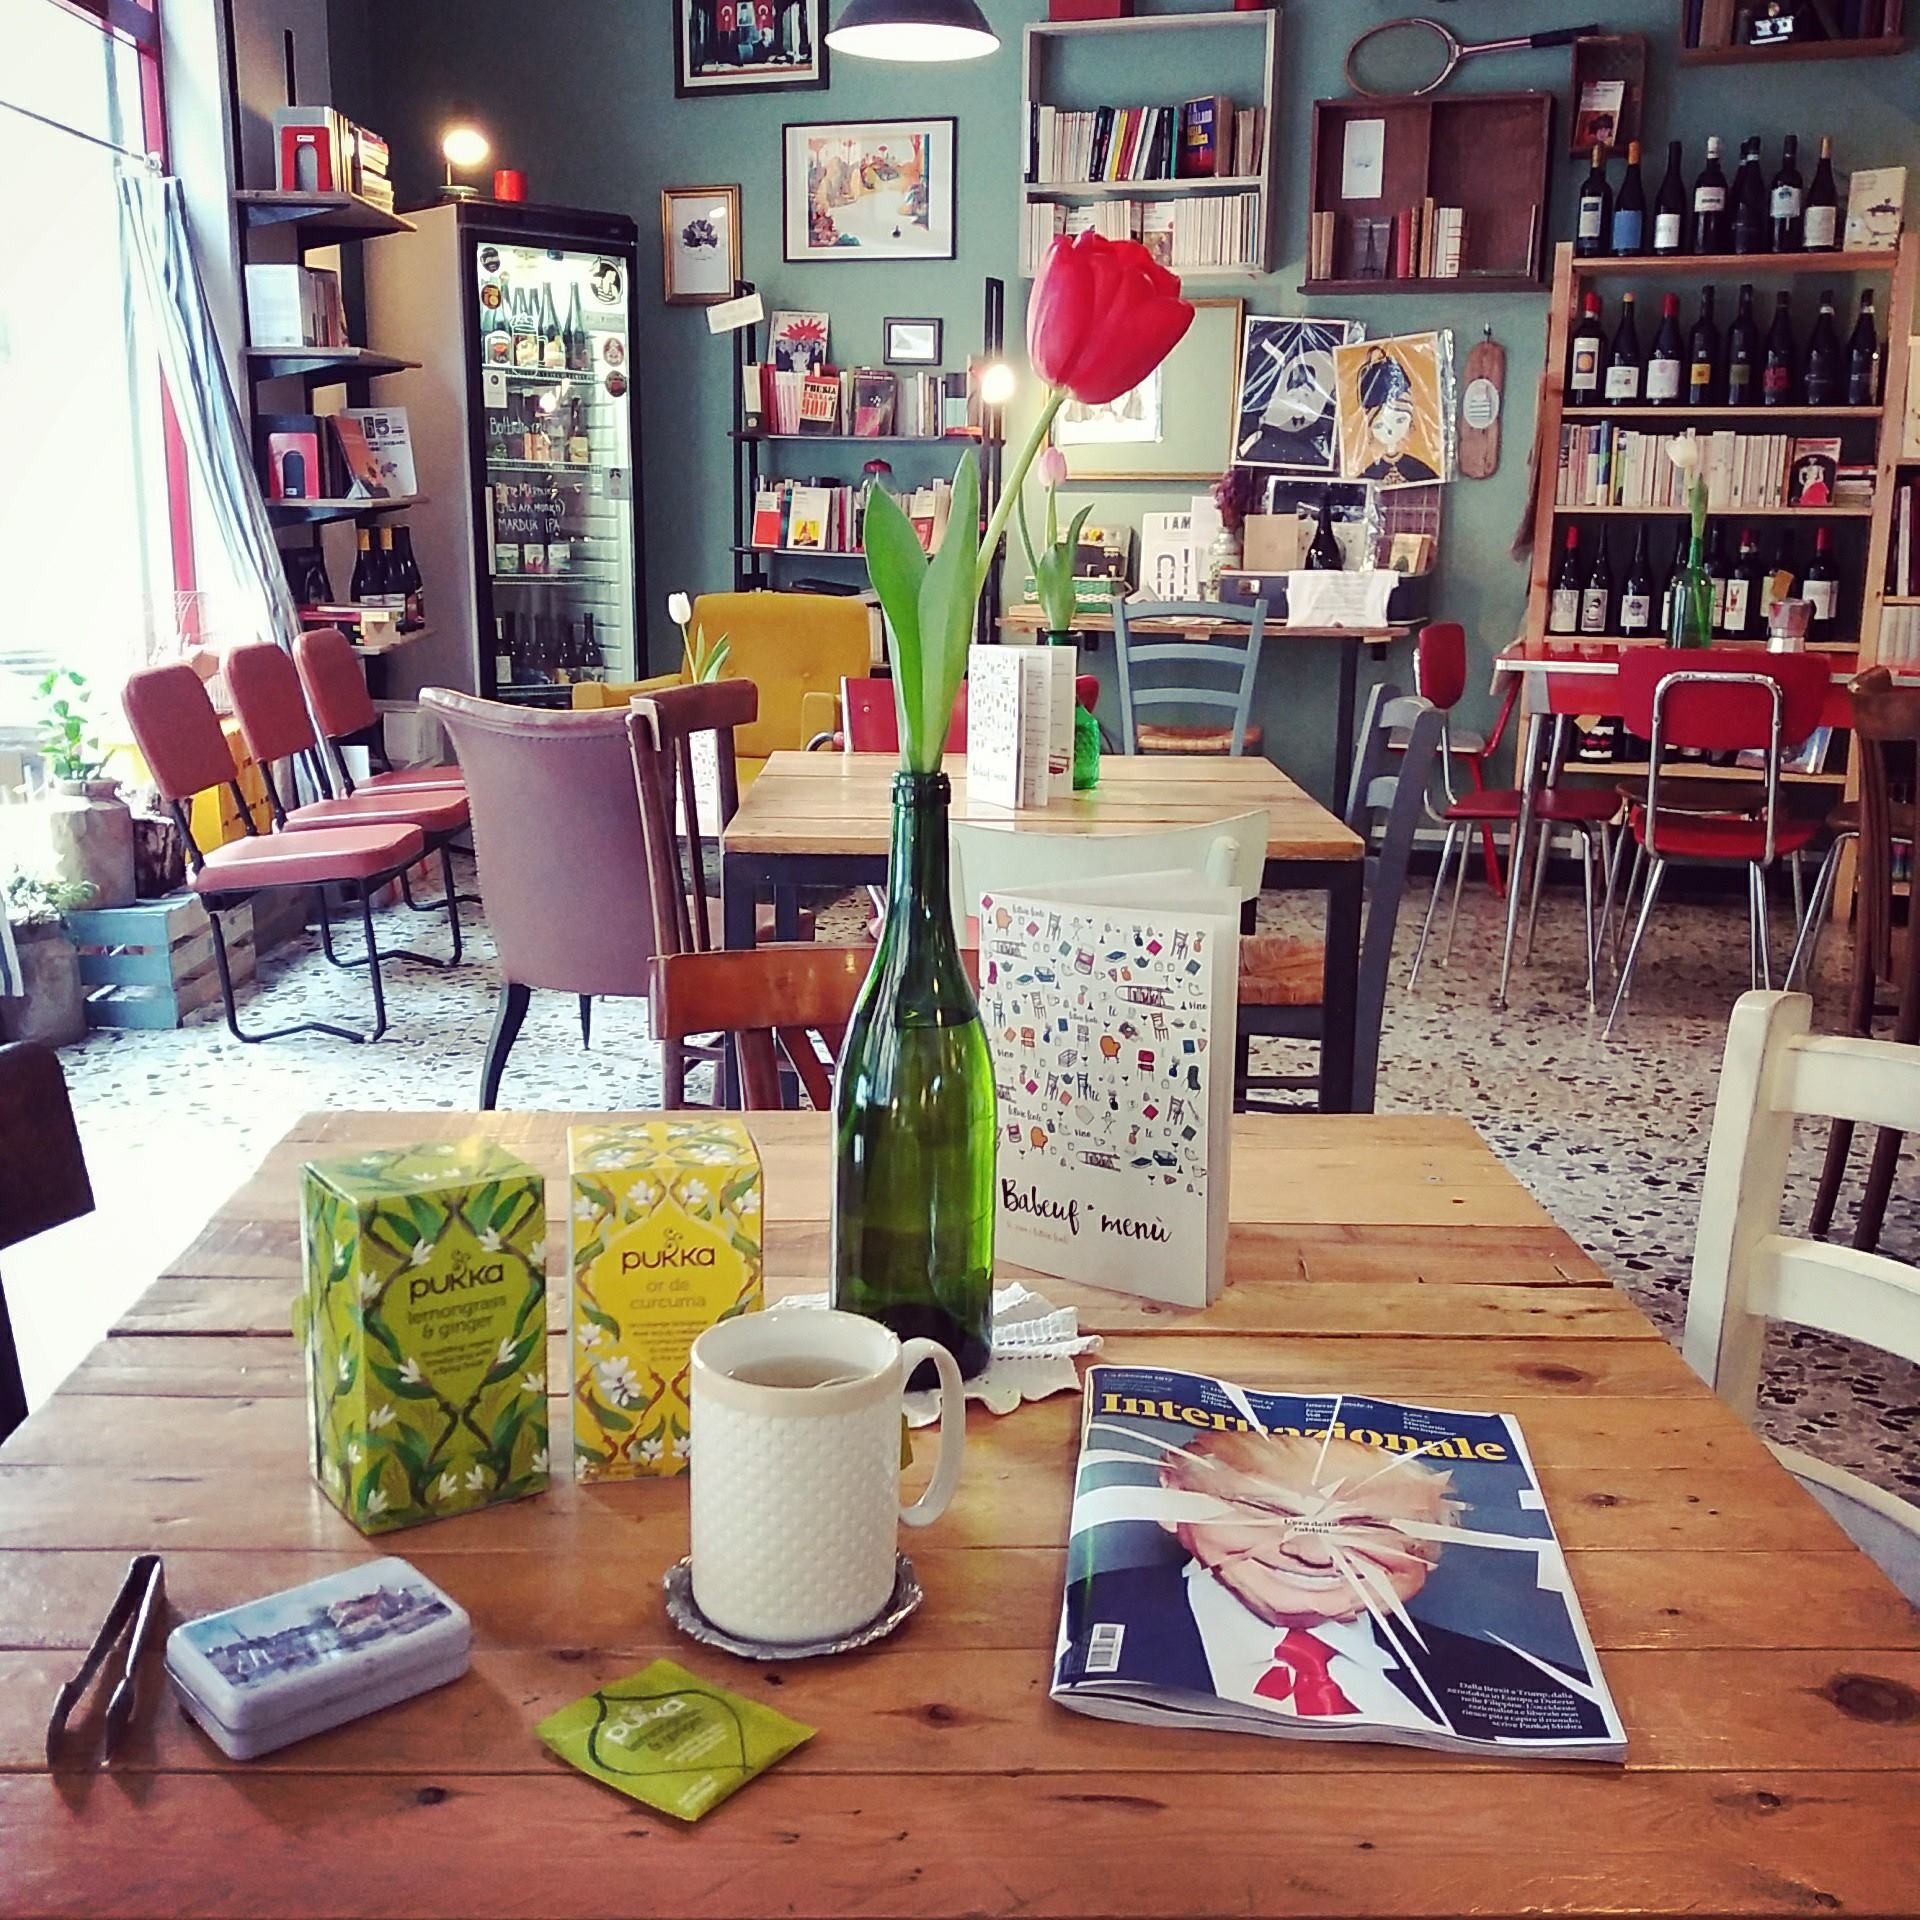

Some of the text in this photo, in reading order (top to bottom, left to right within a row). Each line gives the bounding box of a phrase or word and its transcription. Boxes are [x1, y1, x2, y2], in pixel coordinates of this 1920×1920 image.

[1001, 1177, 1080, 1236] Babeuf
[1101, 1213, 1172, 1243] menù
[621, 1246, 716, 1275] pukka
[409, 1263, 504, 1305] pukka
[646, 1278, 690, 1293] or de
[408, 1294, 507, 1325] lemongrass
[629, 1295, 707, 1310] curcuma
[438, 1314, 494, 1339] ginger
